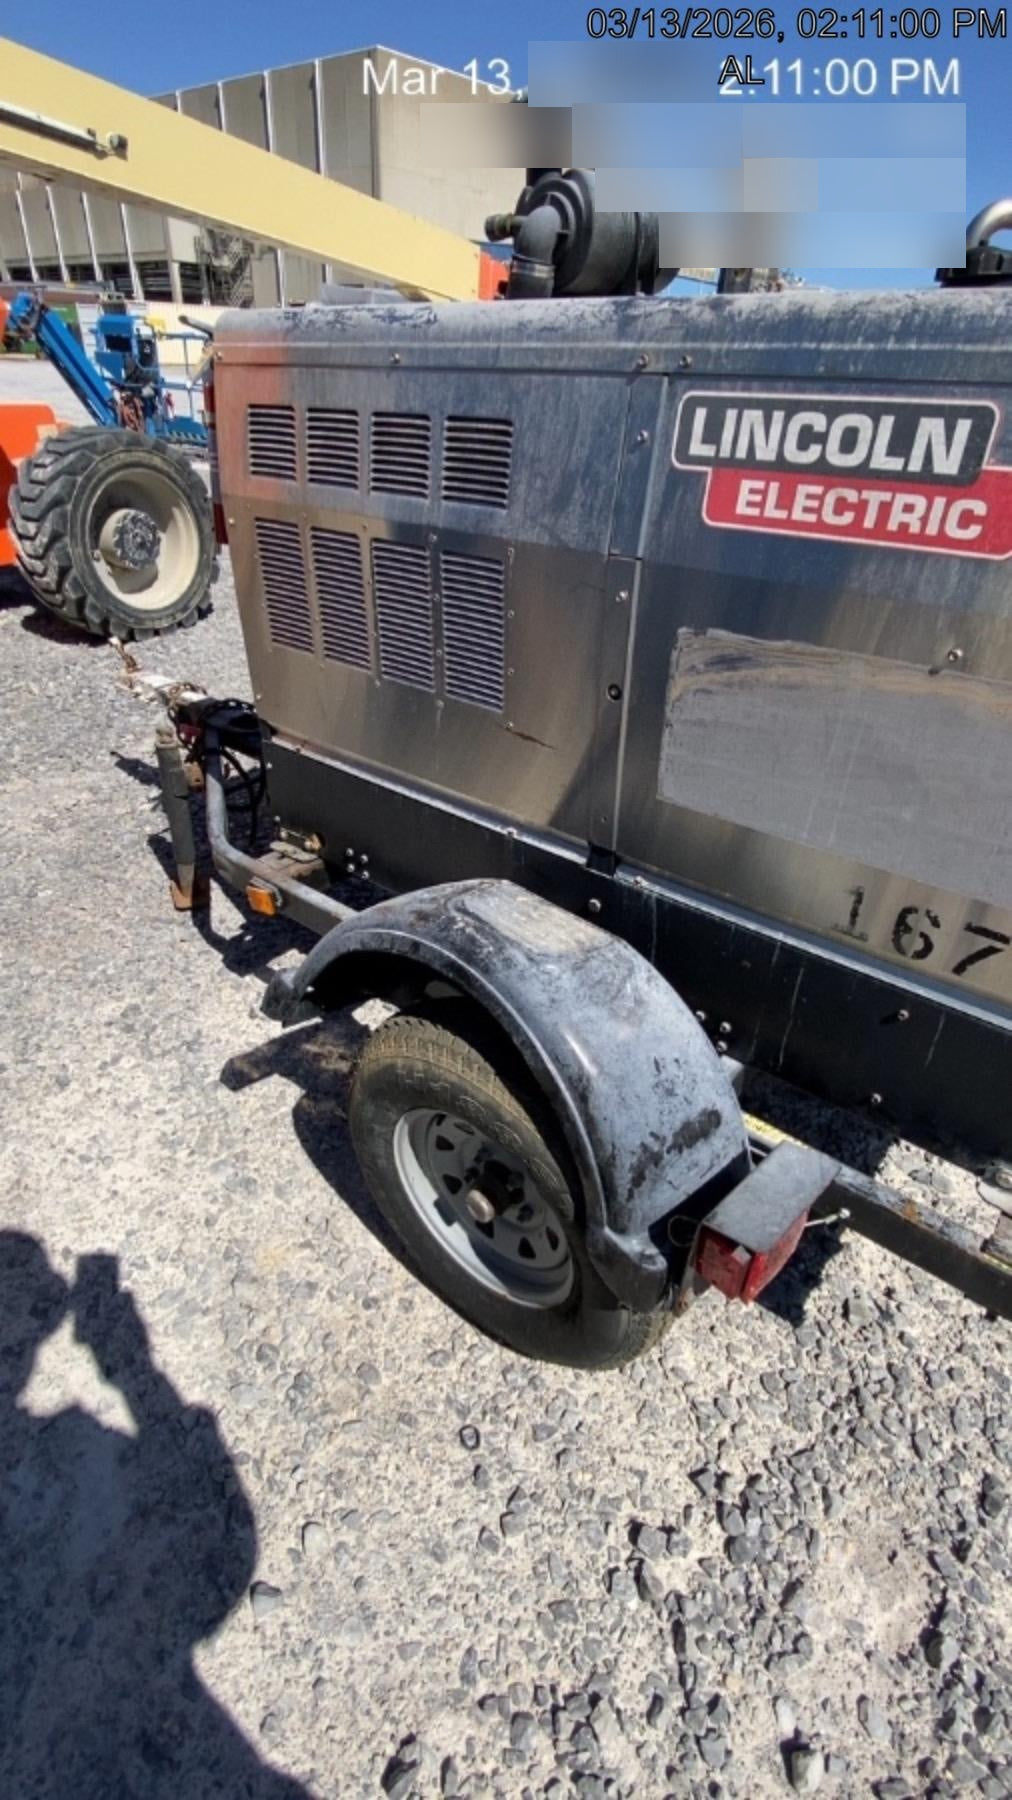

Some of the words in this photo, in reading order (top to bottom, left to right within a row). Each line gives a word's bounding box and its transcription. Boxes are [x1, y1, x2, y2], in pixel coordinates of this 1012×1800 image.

[688, 407, 972, 475] LINCOLN
[735, 479, 987, 540] ELECTRIC
[832, 886, 1010, 976] 167
